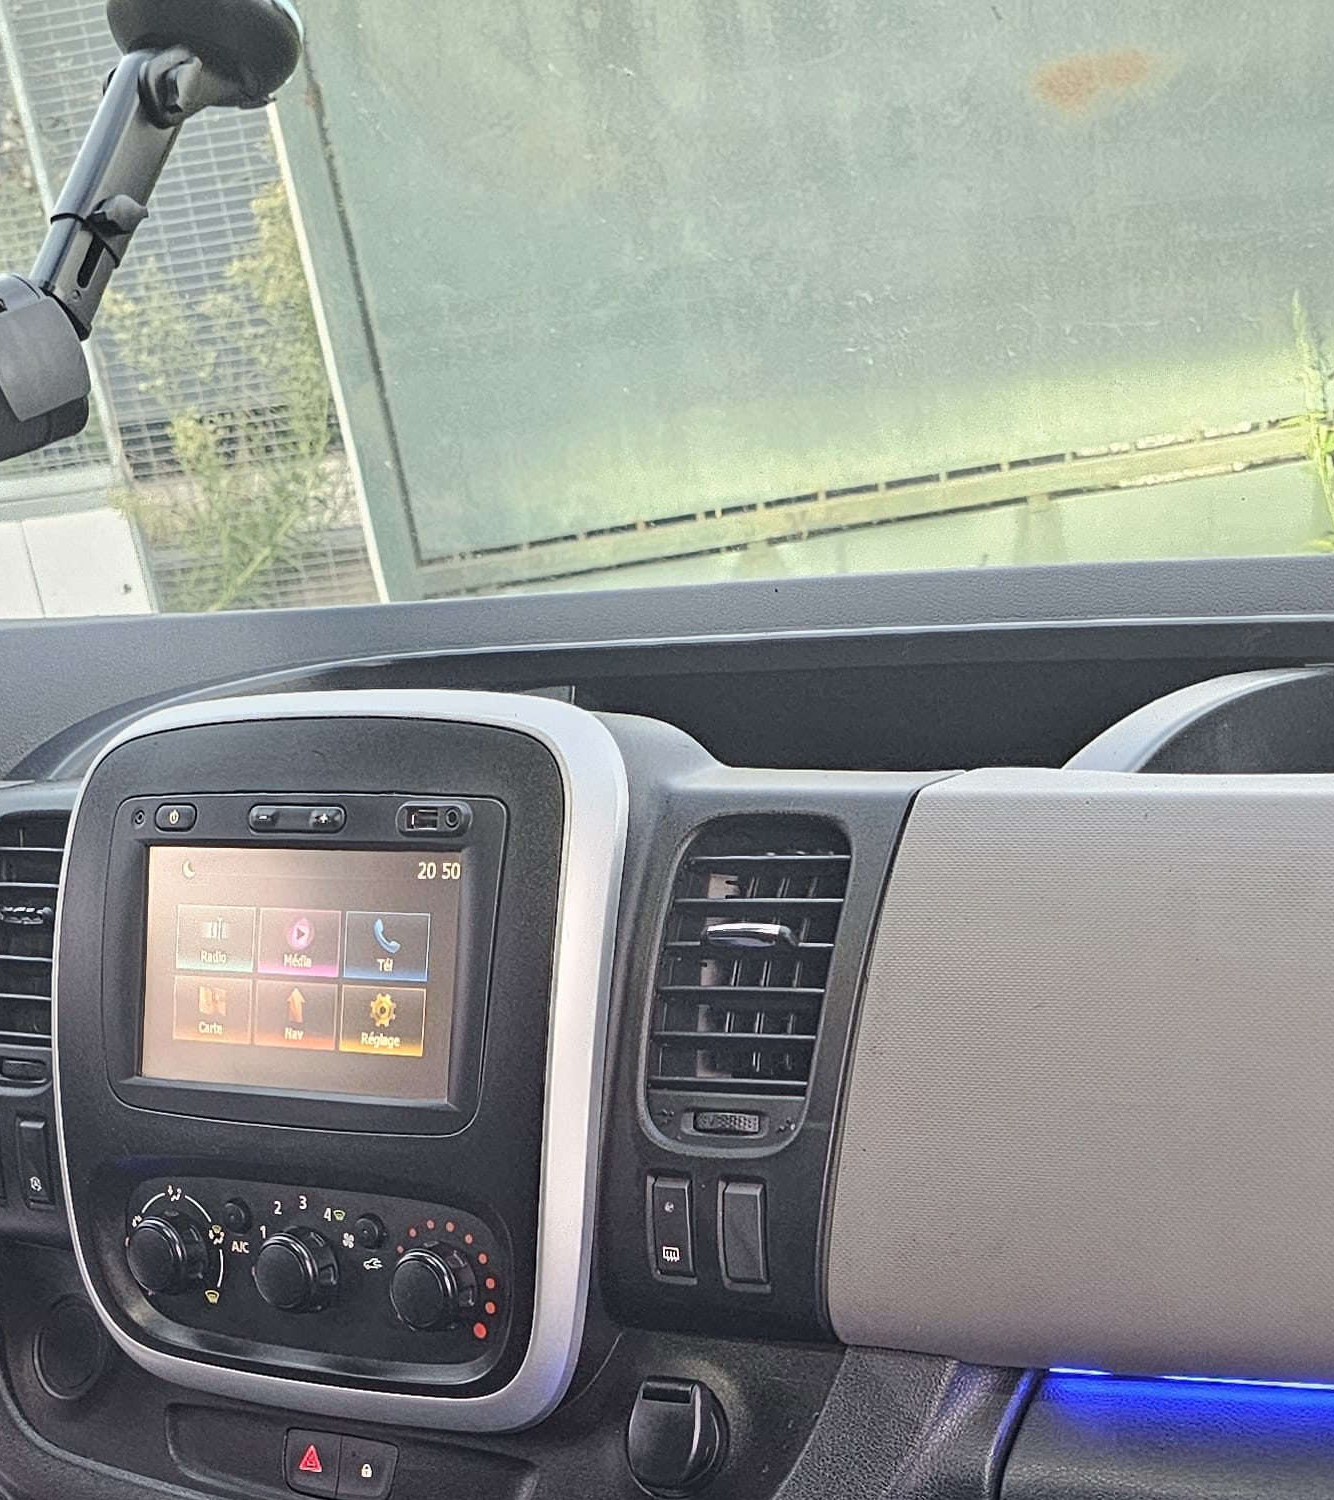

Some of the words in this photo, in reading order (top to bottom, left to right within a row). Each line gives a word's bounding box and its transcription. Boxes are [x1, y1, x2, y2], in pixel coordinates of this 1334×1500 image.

[417, 861, 437, 880] 20
[441, 862, 461, 881] 50
[200, 949, 227, 964] Radio
[283, 953, 312, 968] Média
[376, 957, 394, 972] Tél
[198, 1021, 223, 1034] Carte
[284, 1026, 304, 1040] Nav
[360, 1031, 401, 1050] Réglage
[273, 1200, 283, 1216] 2
[298, 1195, 308, 1210] 3
[323, 1207, 332, 1222] 4
[260, 1225, 267, 1239] 1
[230, 1240, 250, 1254] A/C
